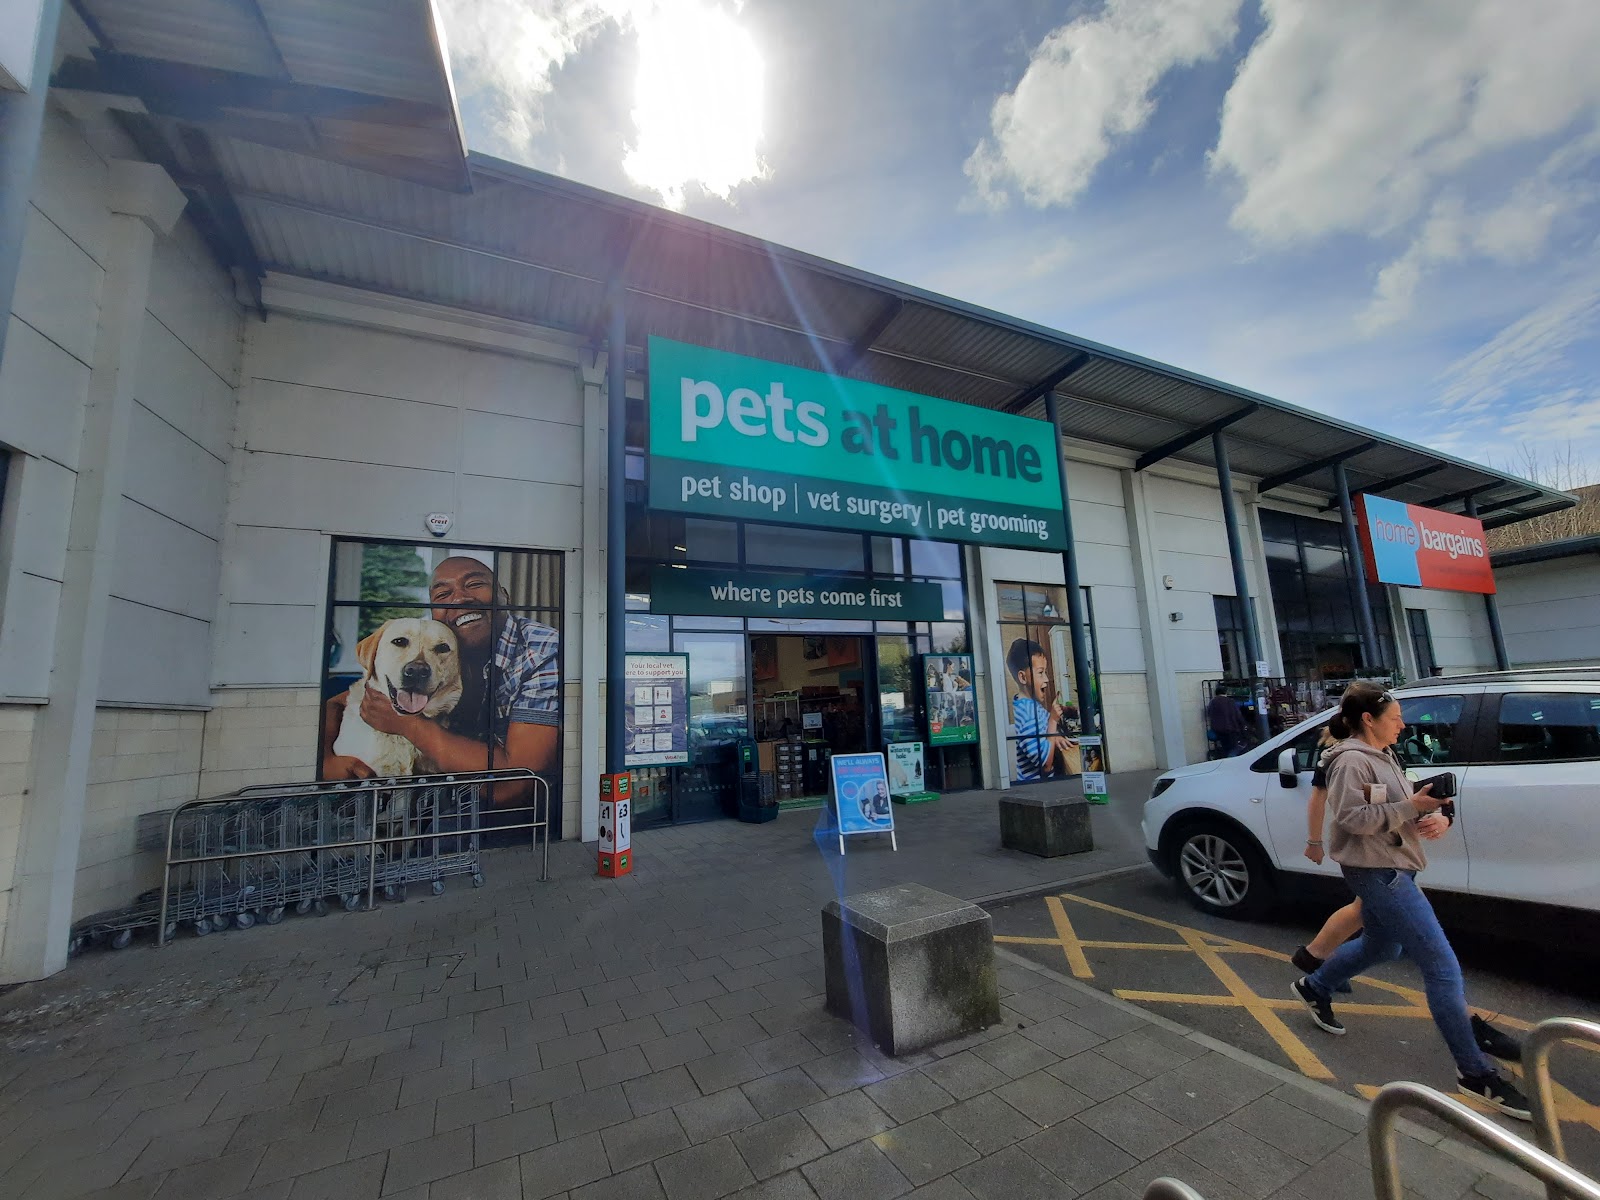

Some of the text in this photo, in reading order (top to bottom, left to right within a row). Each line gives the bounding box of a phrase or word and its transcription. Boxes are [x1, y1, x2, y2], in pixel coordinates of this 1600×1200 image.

[681, 376, 1043, 483] pets at home
[681, 475, 1049, 541] pet shop vet surgery pet grooming
[1375, 513, 1485, 560] home bargains
[710, 580, 903, 608] where pets come first
[645, 669, 671, 677] support
[855, 757, 880, 765] ALWAYS
[602, 805, 610, 820] £1
[619, 803, 628, 819] £3
